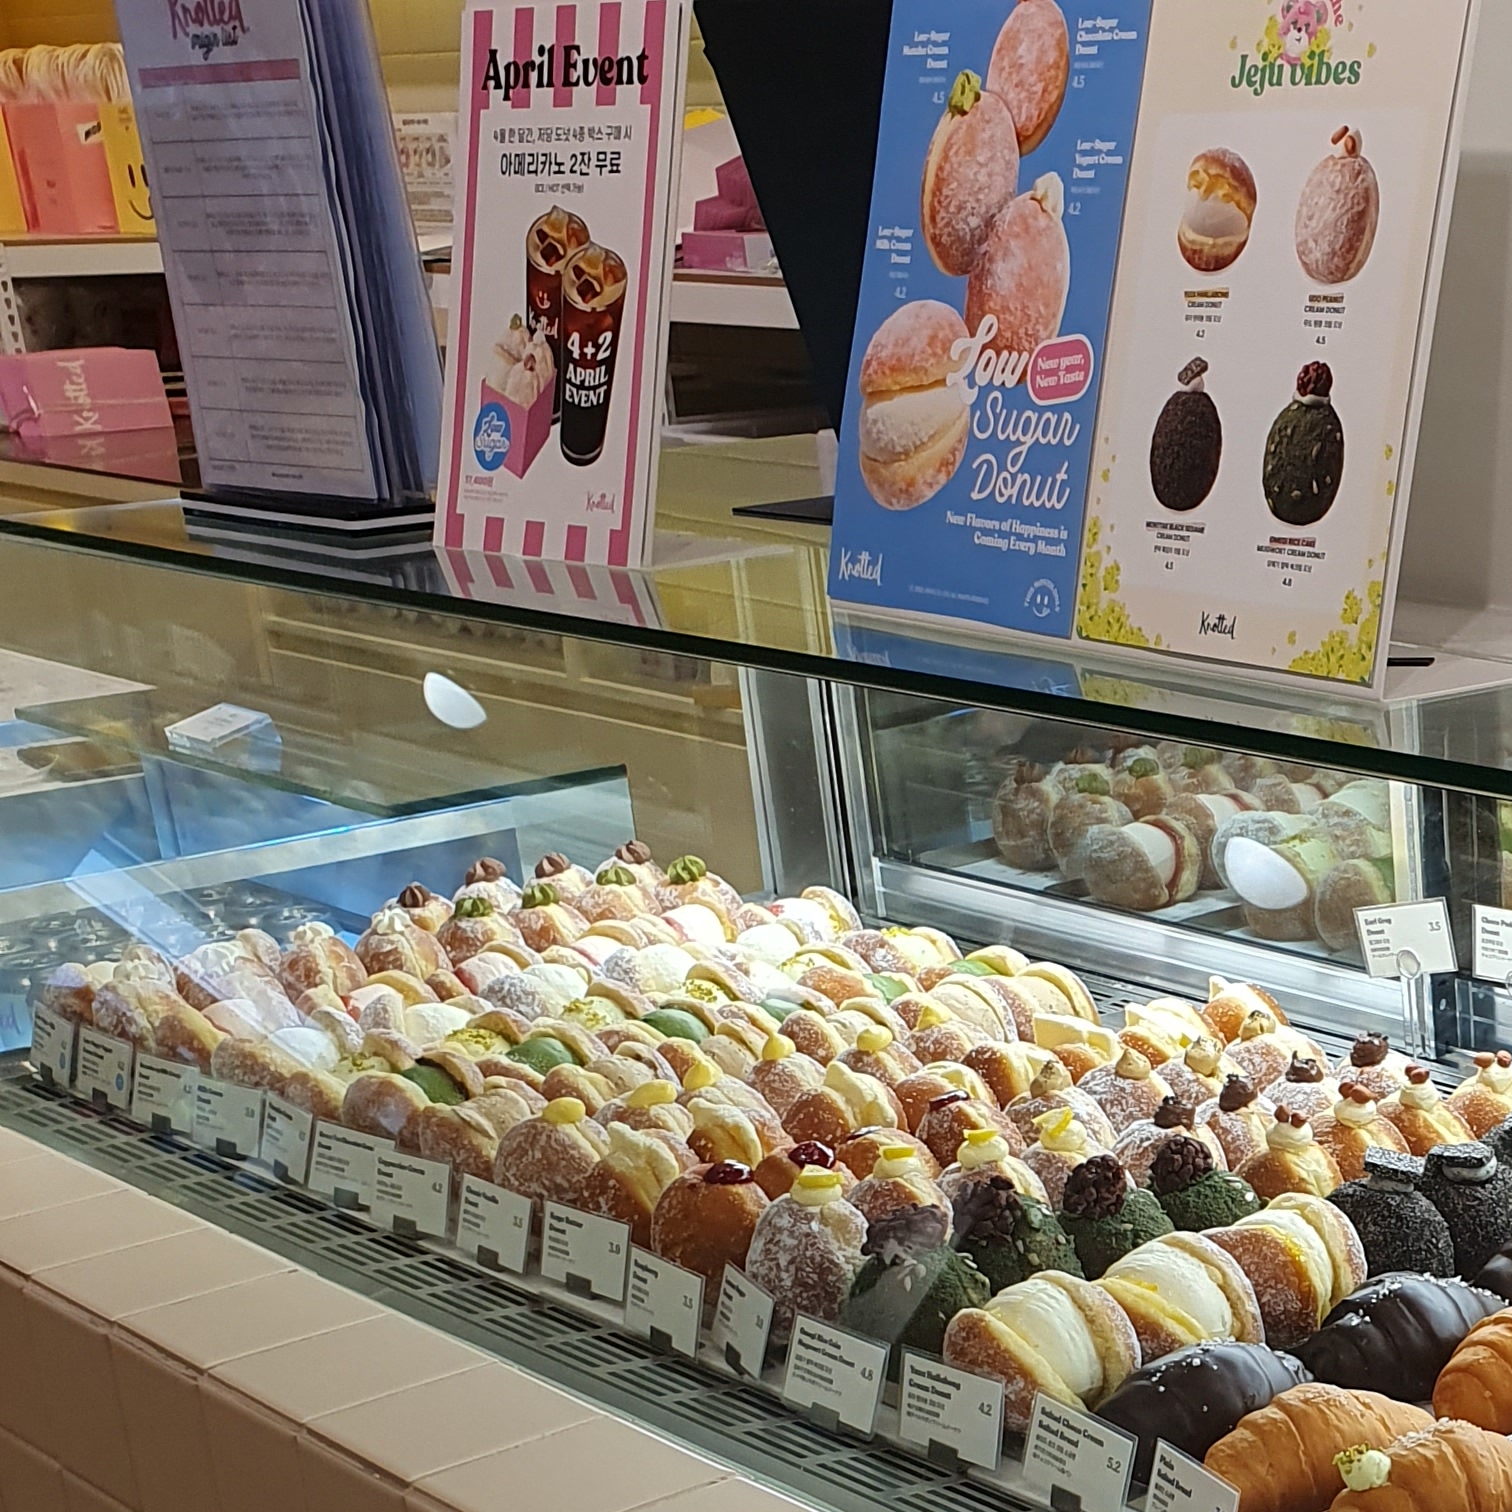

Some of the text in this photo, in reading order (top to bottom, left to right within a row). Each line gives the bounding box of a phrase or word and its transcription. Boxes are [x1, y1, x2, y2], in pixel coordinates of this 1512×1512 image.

[481, 44, 649, 101] April Event
[1231, 50, 1361, 96] Jeju vibes
[555, 127, 571, 142] 도넛
[624, 125, 632, 141] 시
[500, 151, 621, 177] 아메리카노 2잔 무료
[567, 331, 613, 360] 4+2
[946, 314, 1030, 405] Low
[1037, 354, 1084, 371] New year,
[566, 363, 608, 387] APRIL
[1036, 371, 1084, 389] New Taste
[565, 385, 607, 407] EVENT
[973, 391, 1080, 473] Sugar
[970, 453, 1070, 510] Donut
[586, 491, 615, 513] Knotted
[946, 510, 1068, 540] New Flavors of Happiness is
[974, 531, 1066, 557] Coming Every Month
[839, 547, 883, 586] Knotted
[1199, 611, 1237, 640] Knotted
[1429, 921, 1441, 931] 3.5
[1481, 927, 1500, 936] Donut
[861, 1367, 873, 1381] 4.8
[978, 1402, 992, 1417] 4.2
[1083, 1428, 1104, 1448] Cream
[1107, 1457, 1121, 1474] 5.2
[1160, 1454, 1174, 1471] Plain
[1157, 1468, 1192, 1498] Salted Bread
